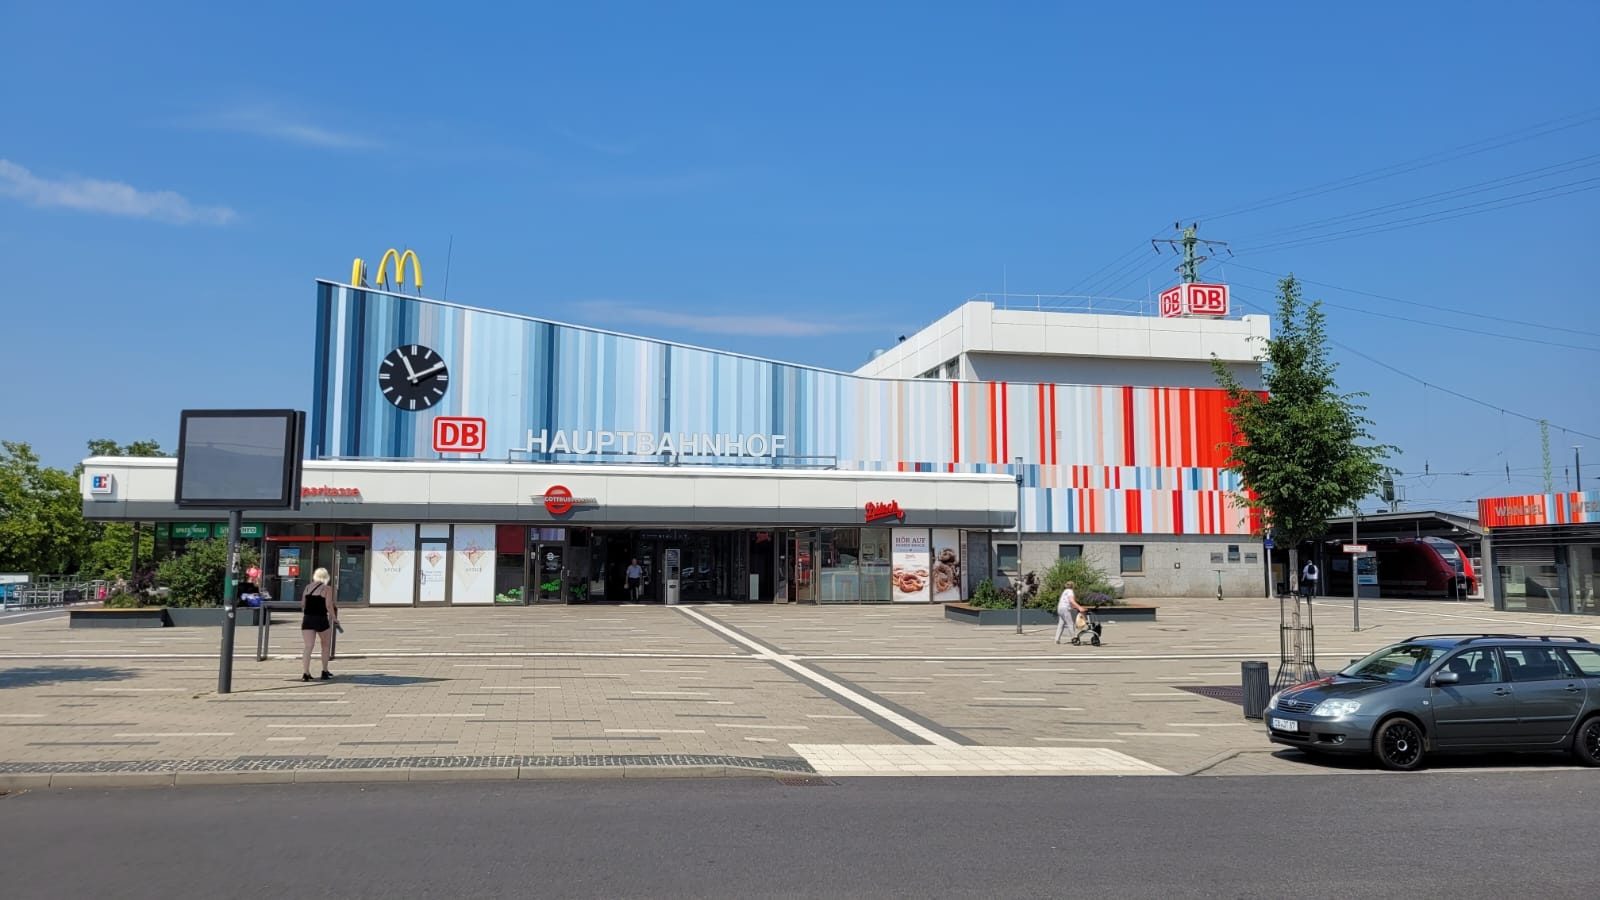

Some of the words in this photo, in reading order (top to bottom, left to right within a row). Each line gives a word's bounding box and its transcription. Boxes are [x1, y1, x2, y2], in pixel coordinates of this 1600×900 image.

[1164, 292, 1180, 315] DB
[1193, 289, 1221, 309] DB
[440, 422, 480, 447] DB
[526, 429, 787, 458] HAUPTBAHNHOF
[302, 485, 360, 498] parkasse
[1496, 504, 1543, 517] WANDEL
